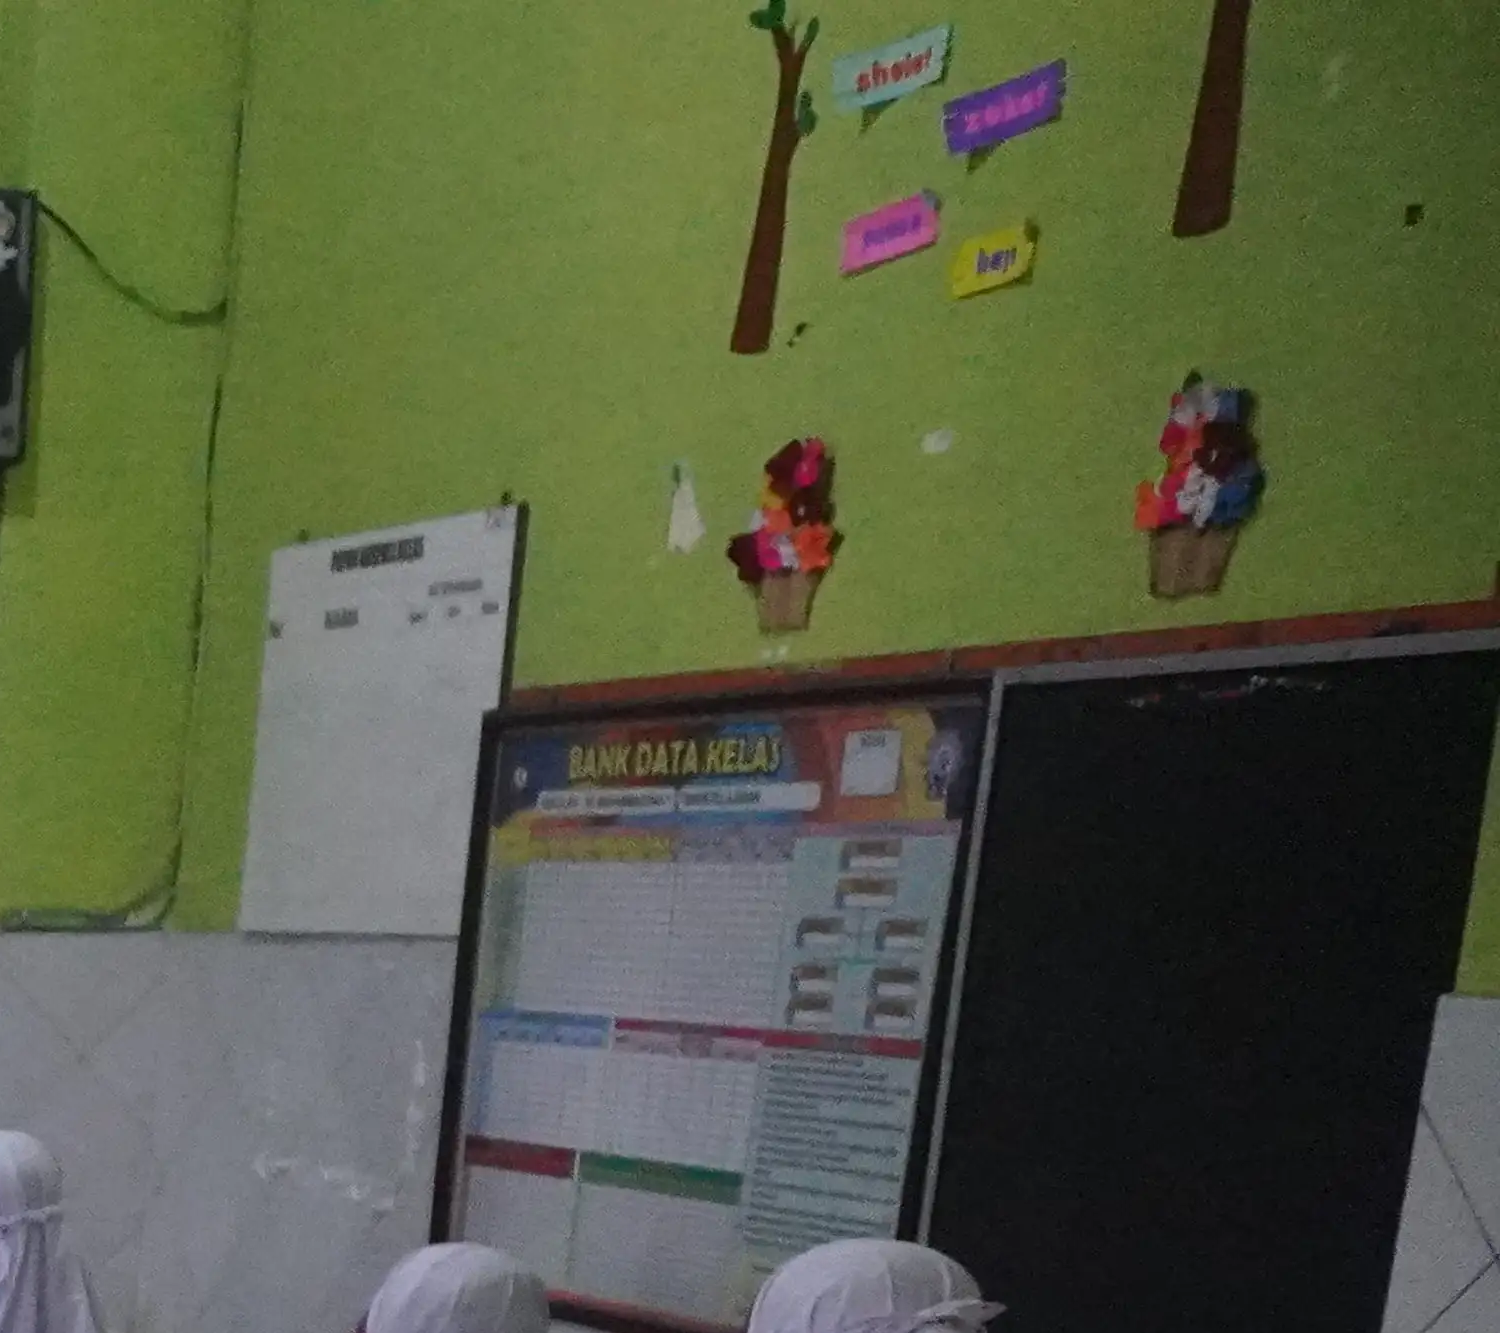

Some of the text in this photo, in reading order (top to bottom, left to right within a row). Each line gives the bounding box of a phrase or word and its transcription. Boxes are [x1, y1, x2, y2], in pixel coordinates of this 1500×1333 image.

[568, 736, 782, 780] BANK DATA KELAS
